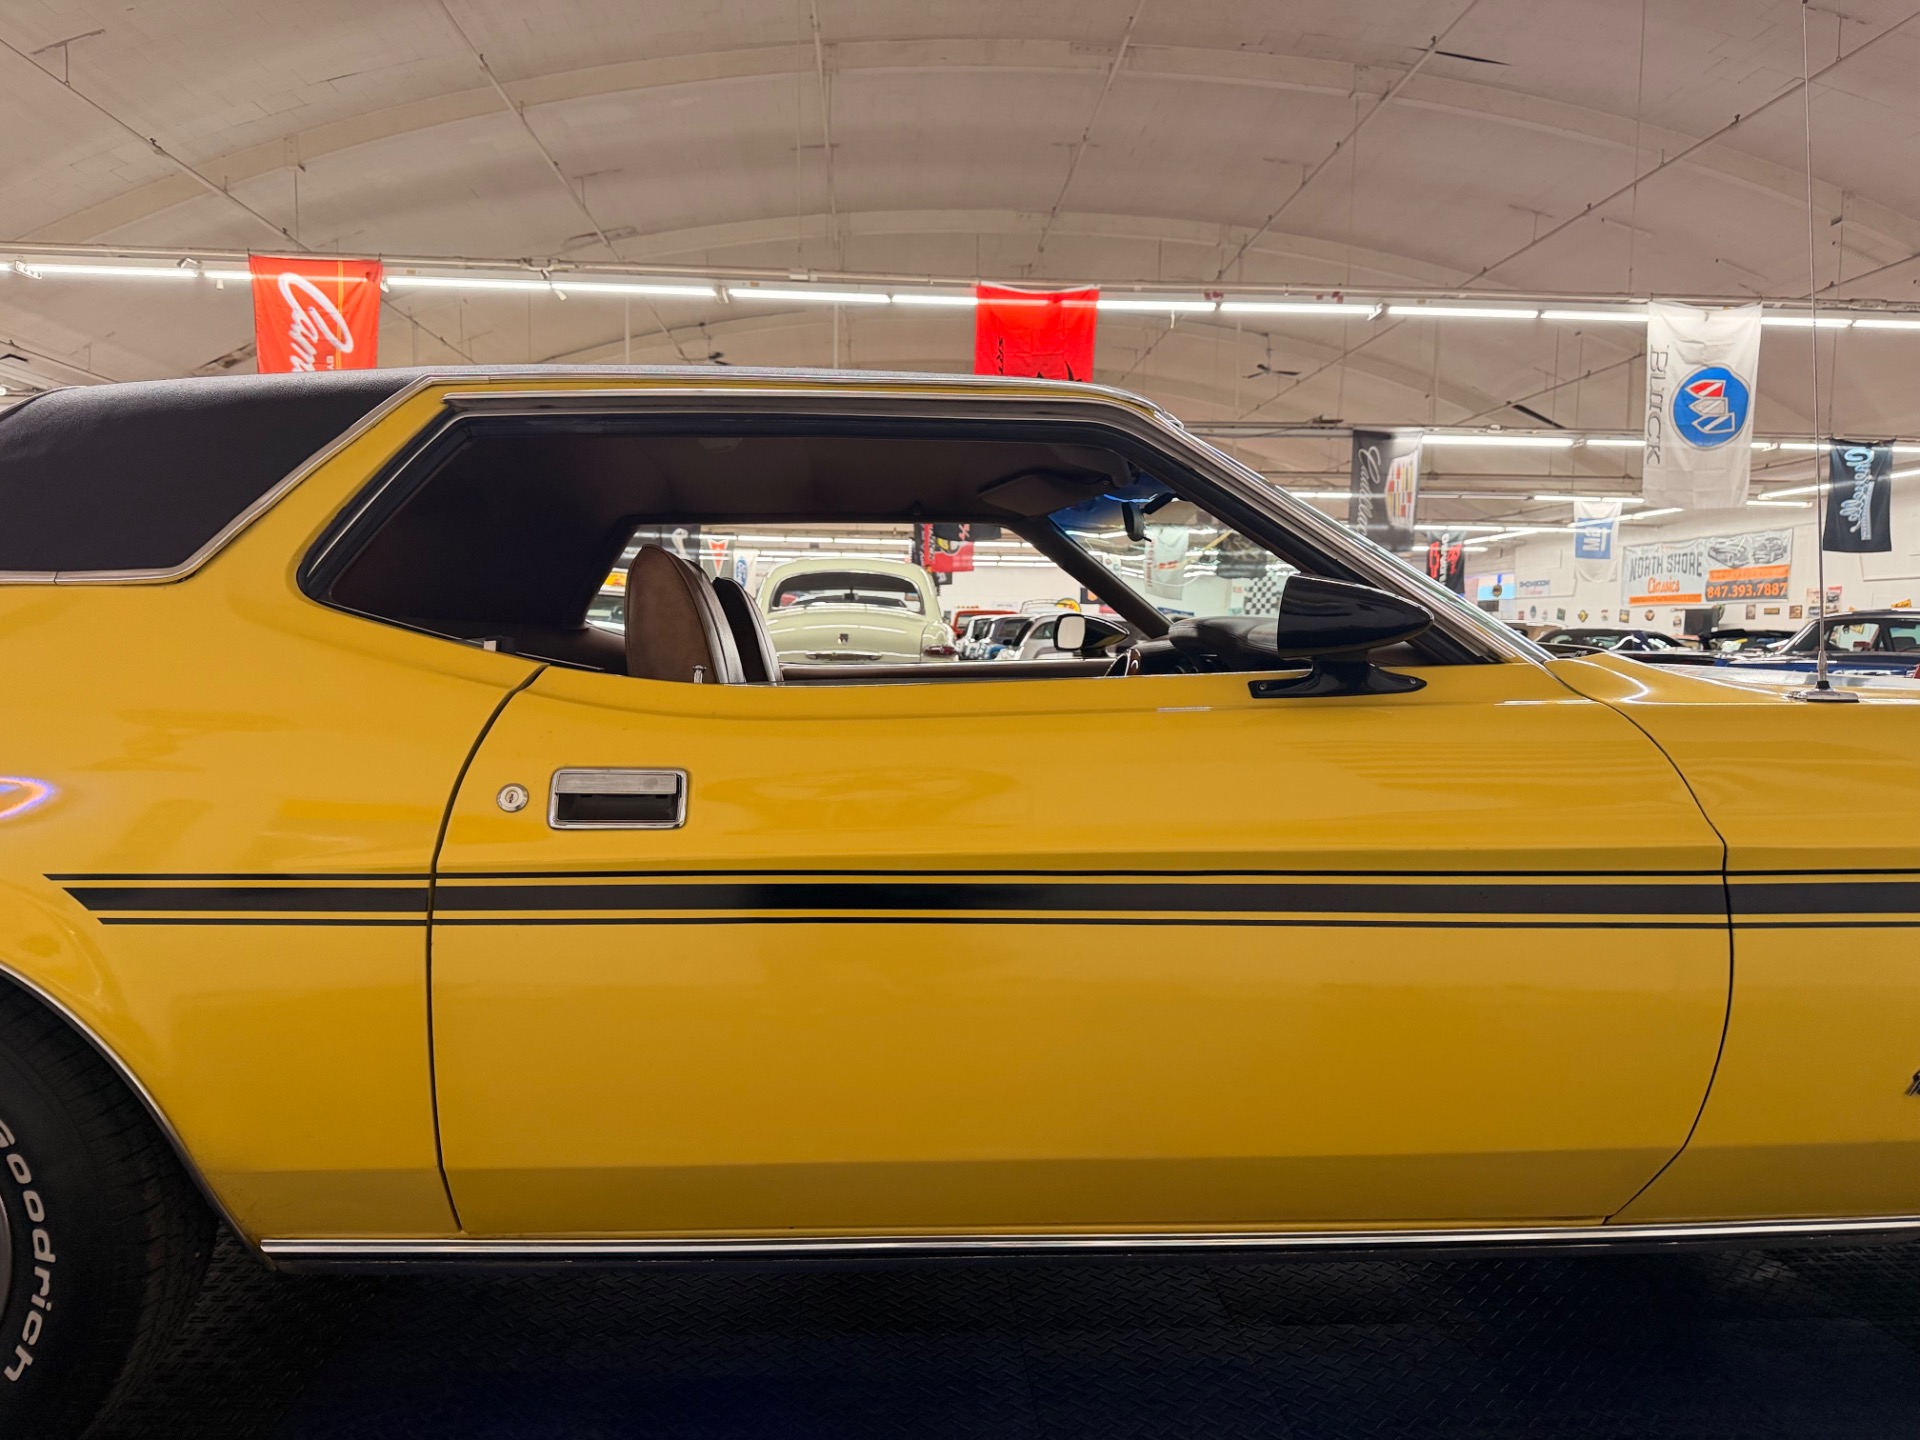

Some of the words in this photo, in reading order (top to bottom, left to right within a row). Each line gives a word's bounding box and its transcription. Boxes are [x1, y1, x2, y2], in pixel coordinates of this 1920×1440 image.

[1628, 556, 1664, 583] NORTH
[1666, 551, 1703, 578] SHORE
[1647, 575, 1681, 594] Classics
[1706, 582, 1788, 599] 847.393.7887
